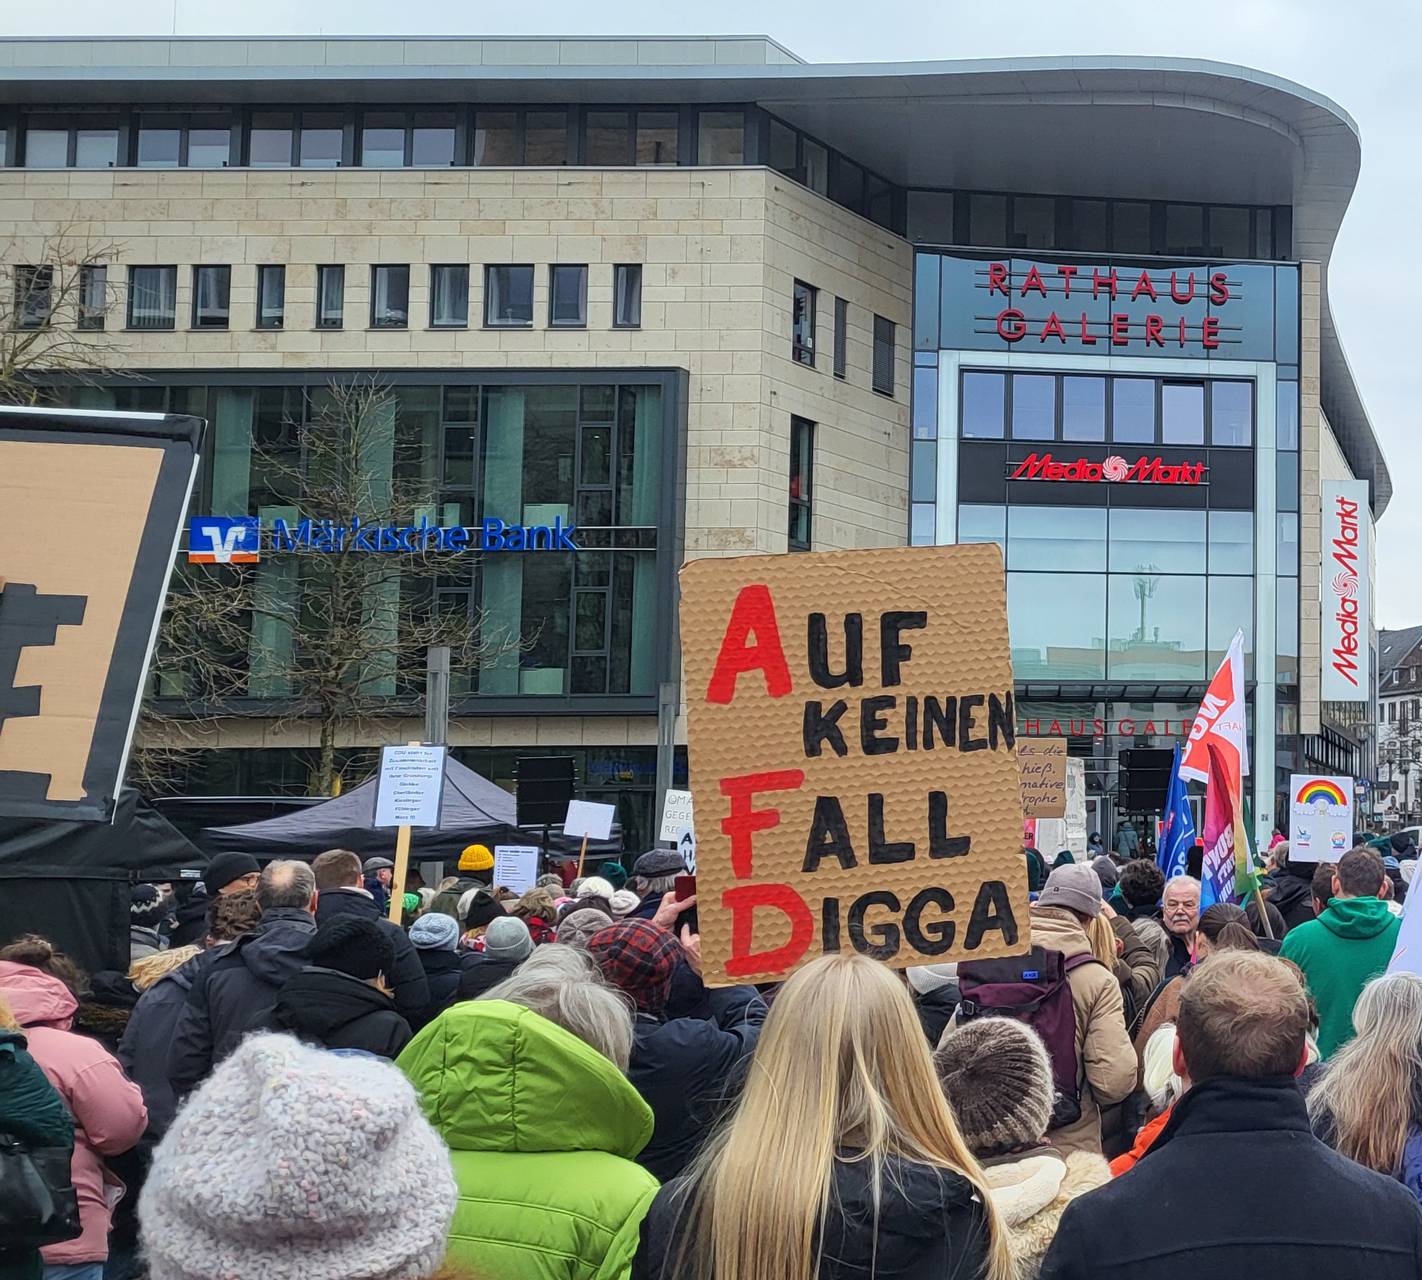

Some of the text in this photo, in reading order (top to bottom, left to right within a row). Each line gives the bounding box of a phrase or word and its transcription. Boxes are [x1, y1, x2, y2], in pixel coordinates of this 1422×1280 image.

[988, 263, 1229, 306] RATHAUS
[996, 309, 1220, 349] GALERIE
[1011, 453, 1206, 483] Media Markt
[273, 514, 580, 552] Märkische Bank
[1332, 496, 1358, 687] Media Markt
[705, 584, 928, 704] AUF
[802, 690, 1015, 757] KEINEN
[719, 769, 972, 880] FALL
[721, 883, 1018, 977] DIGGA
